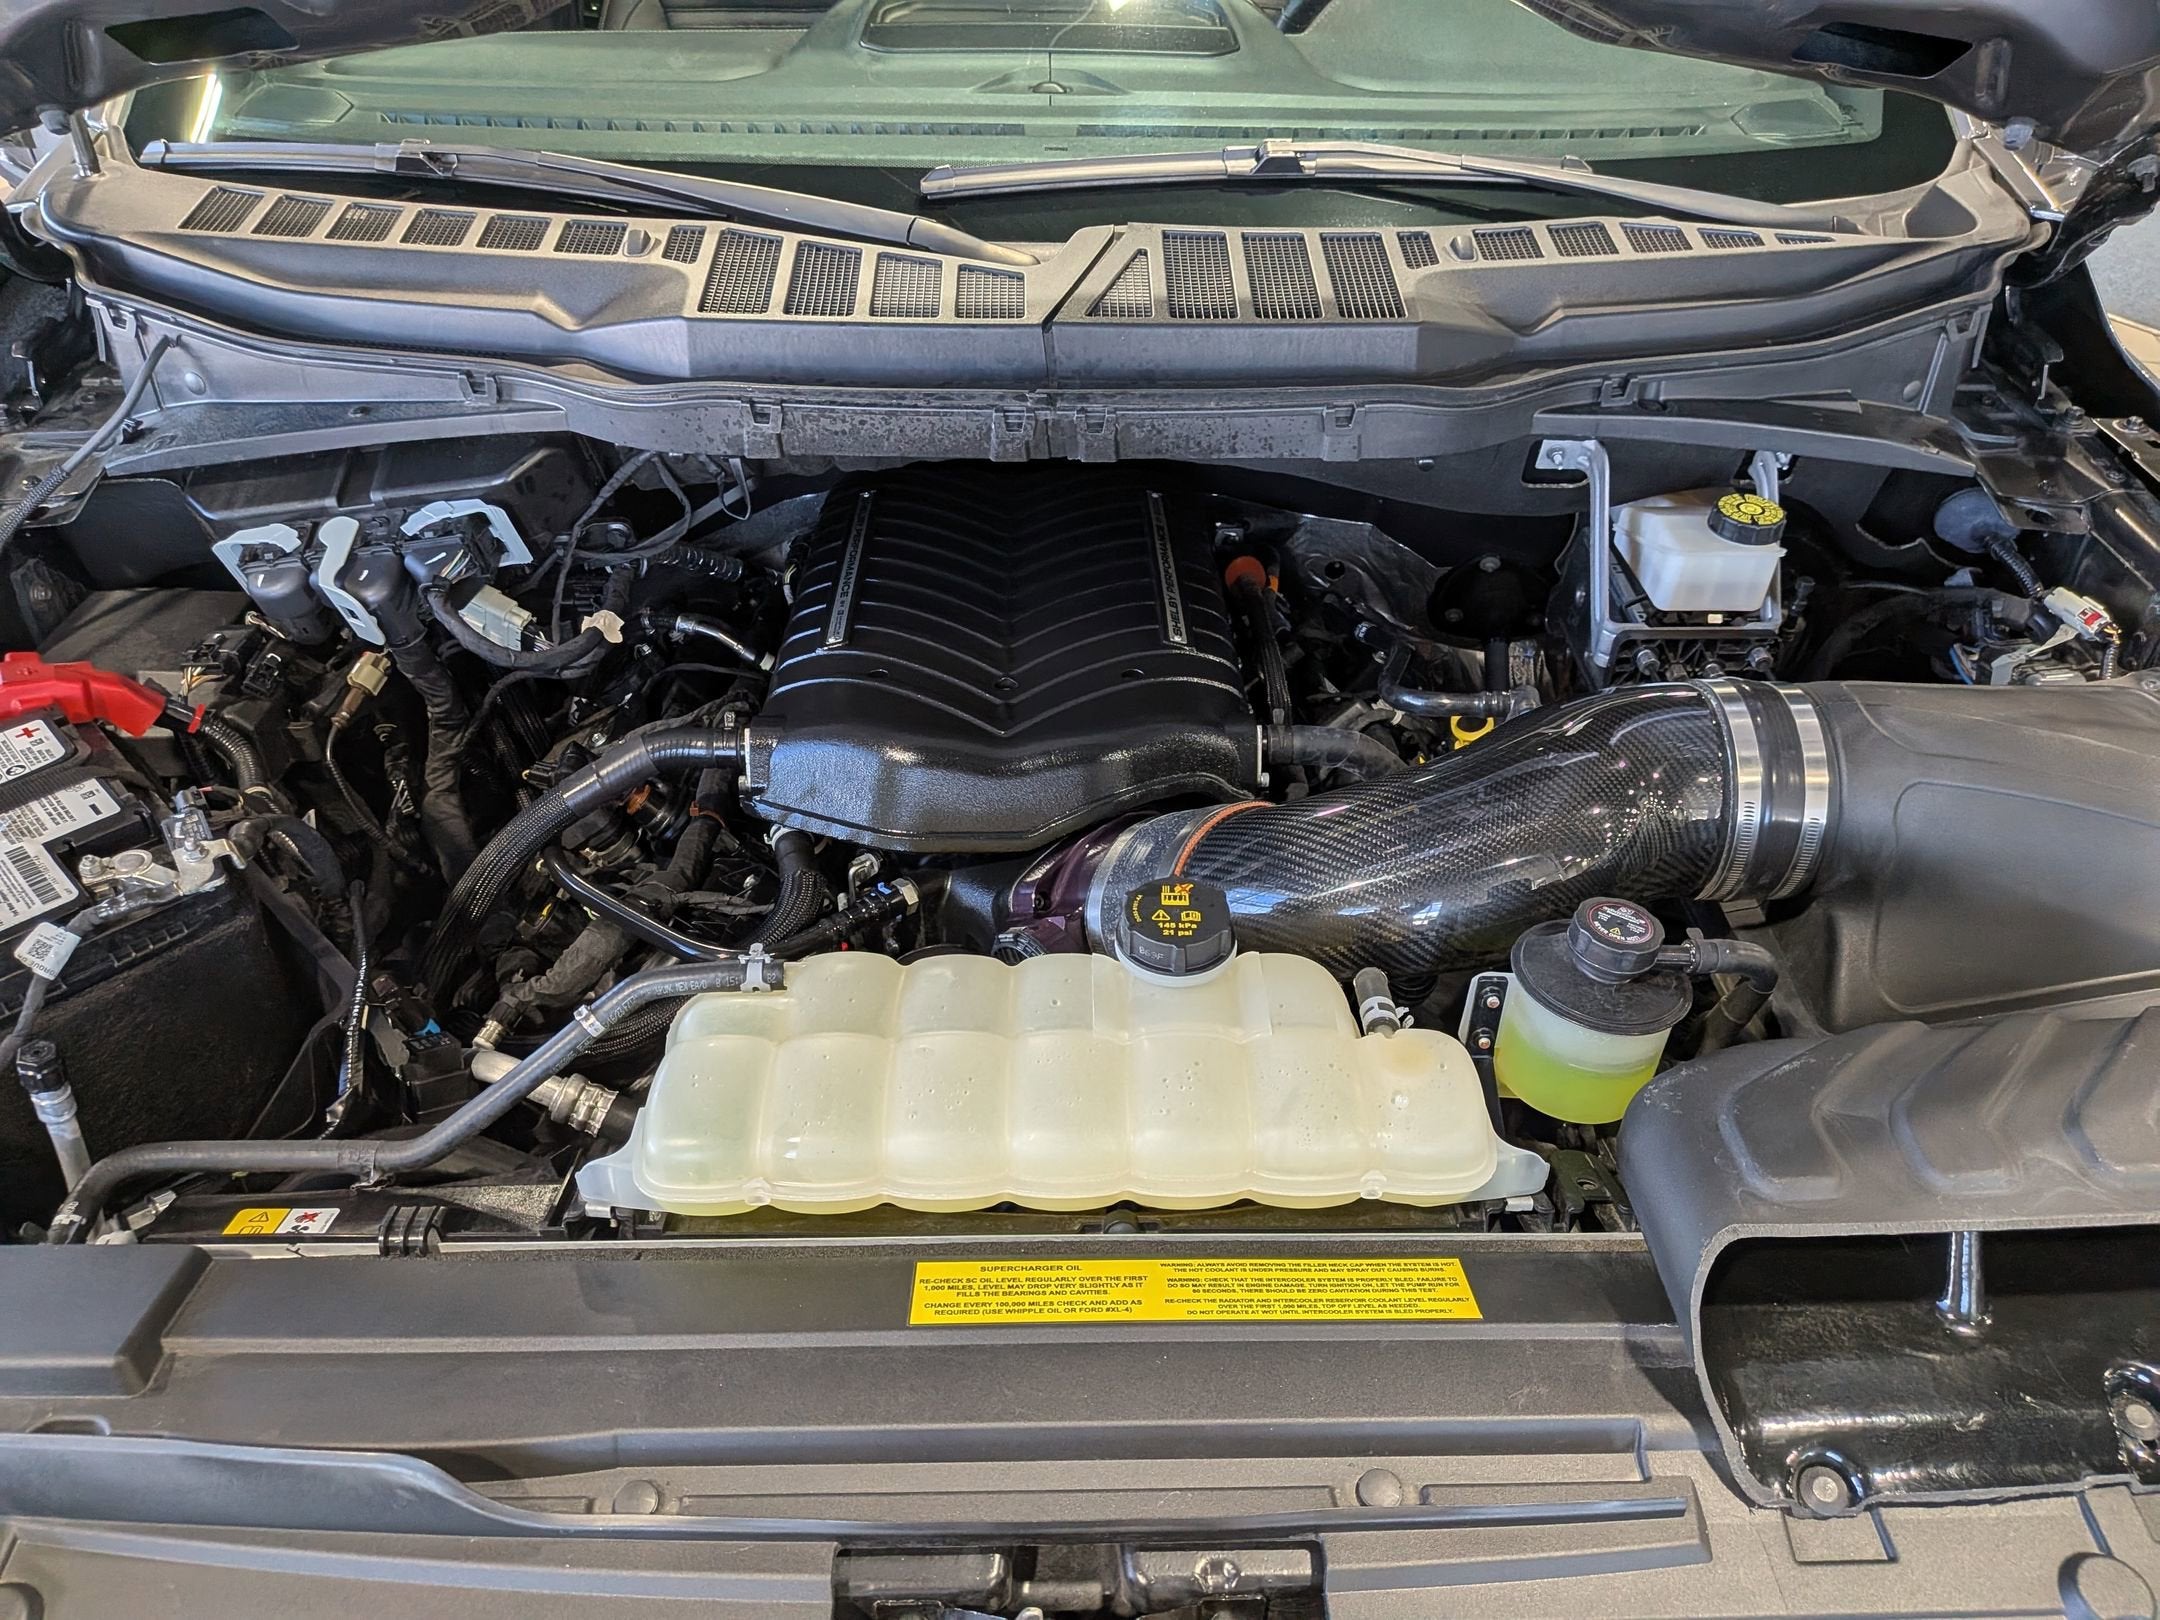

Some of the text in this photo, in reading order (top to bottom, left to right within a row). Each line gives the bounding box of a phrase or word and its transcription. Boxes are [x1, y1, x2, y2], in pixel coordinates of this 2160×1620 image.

[840, 528, 862, 598] PERFORMANCE
[1156, 524, 1176, 594] PERFORMANCE
[1168, 594, 1182, 636] SHELBY
